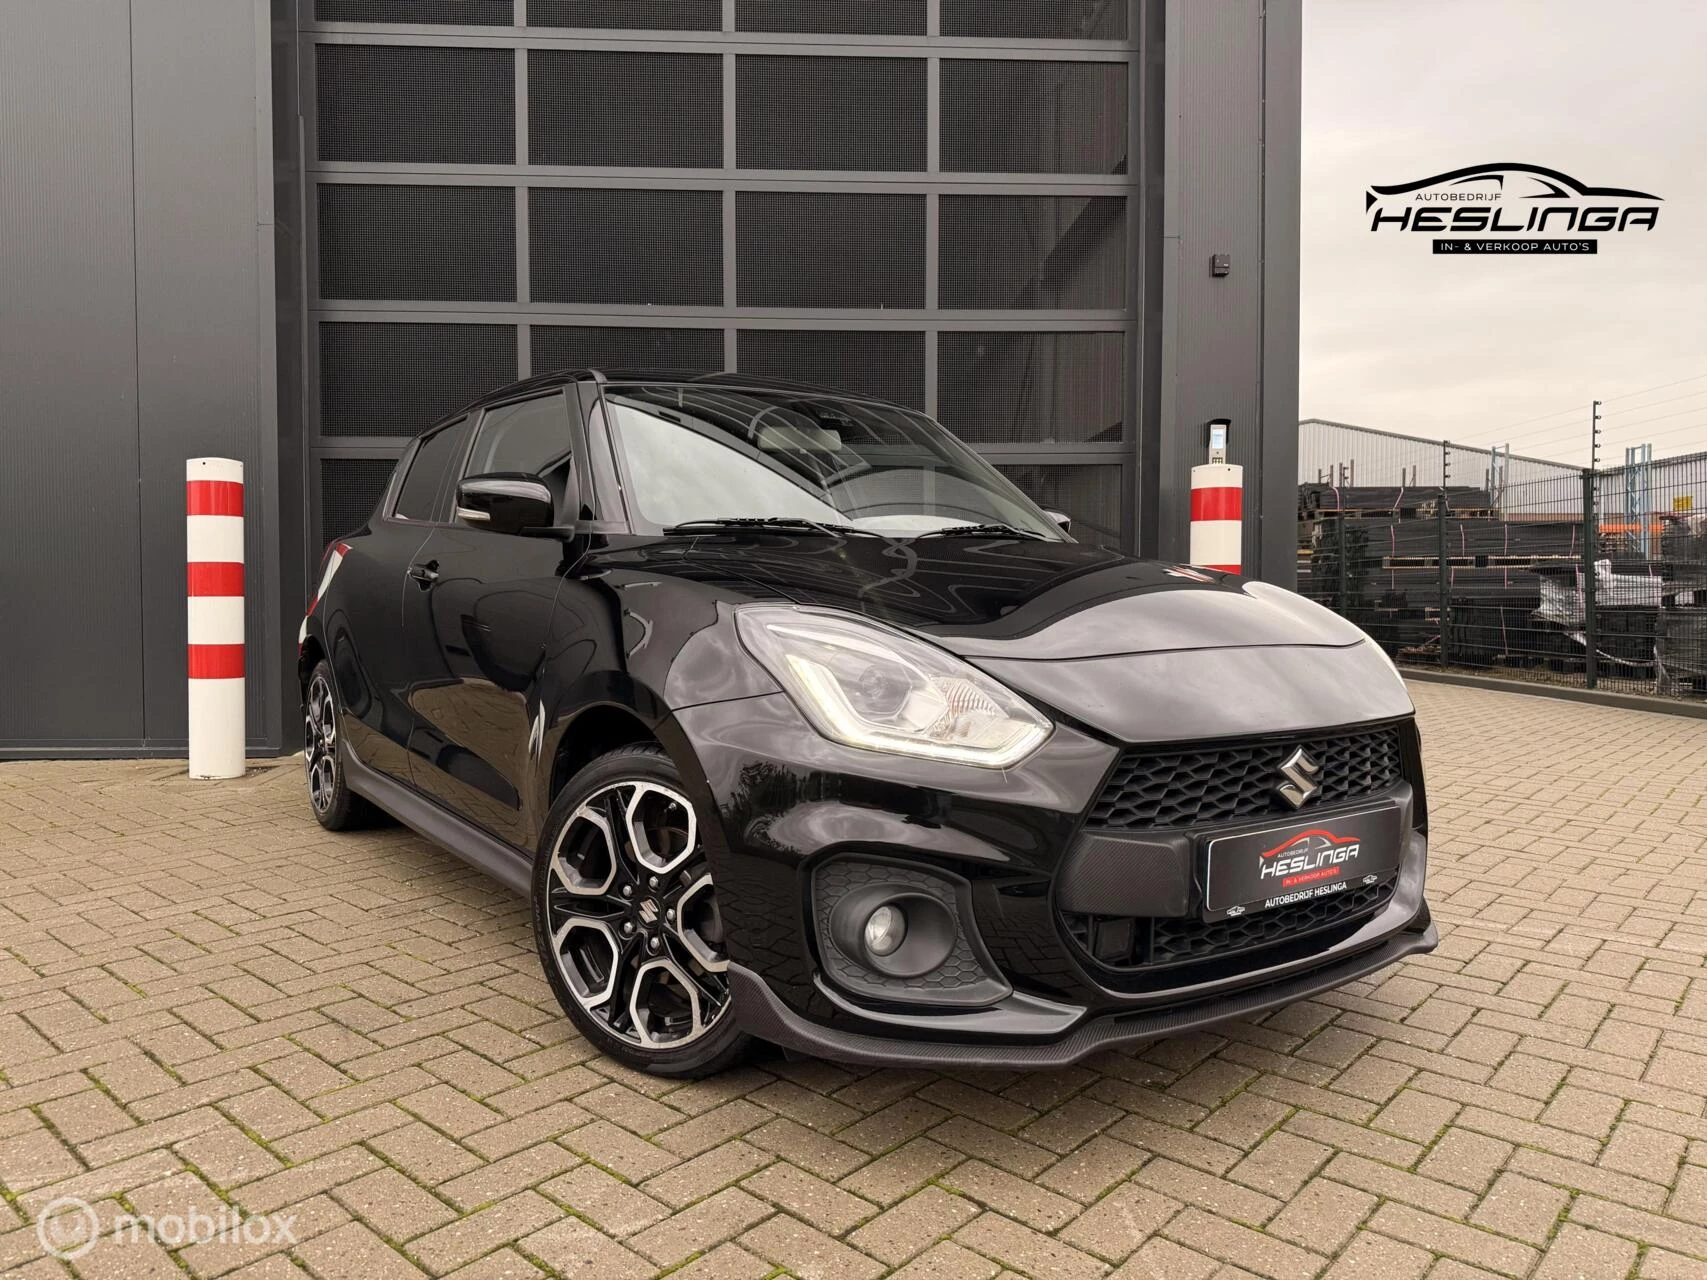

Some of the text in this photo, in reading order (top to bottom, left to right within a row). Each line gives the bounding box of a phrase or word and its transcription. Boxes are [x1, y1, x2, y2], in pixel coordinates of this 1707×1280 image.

[1260, 844, 1360, 880] HESLINGA
[1264, 881, 1347, 908] AUTOBEDRIJF HESLINGA
